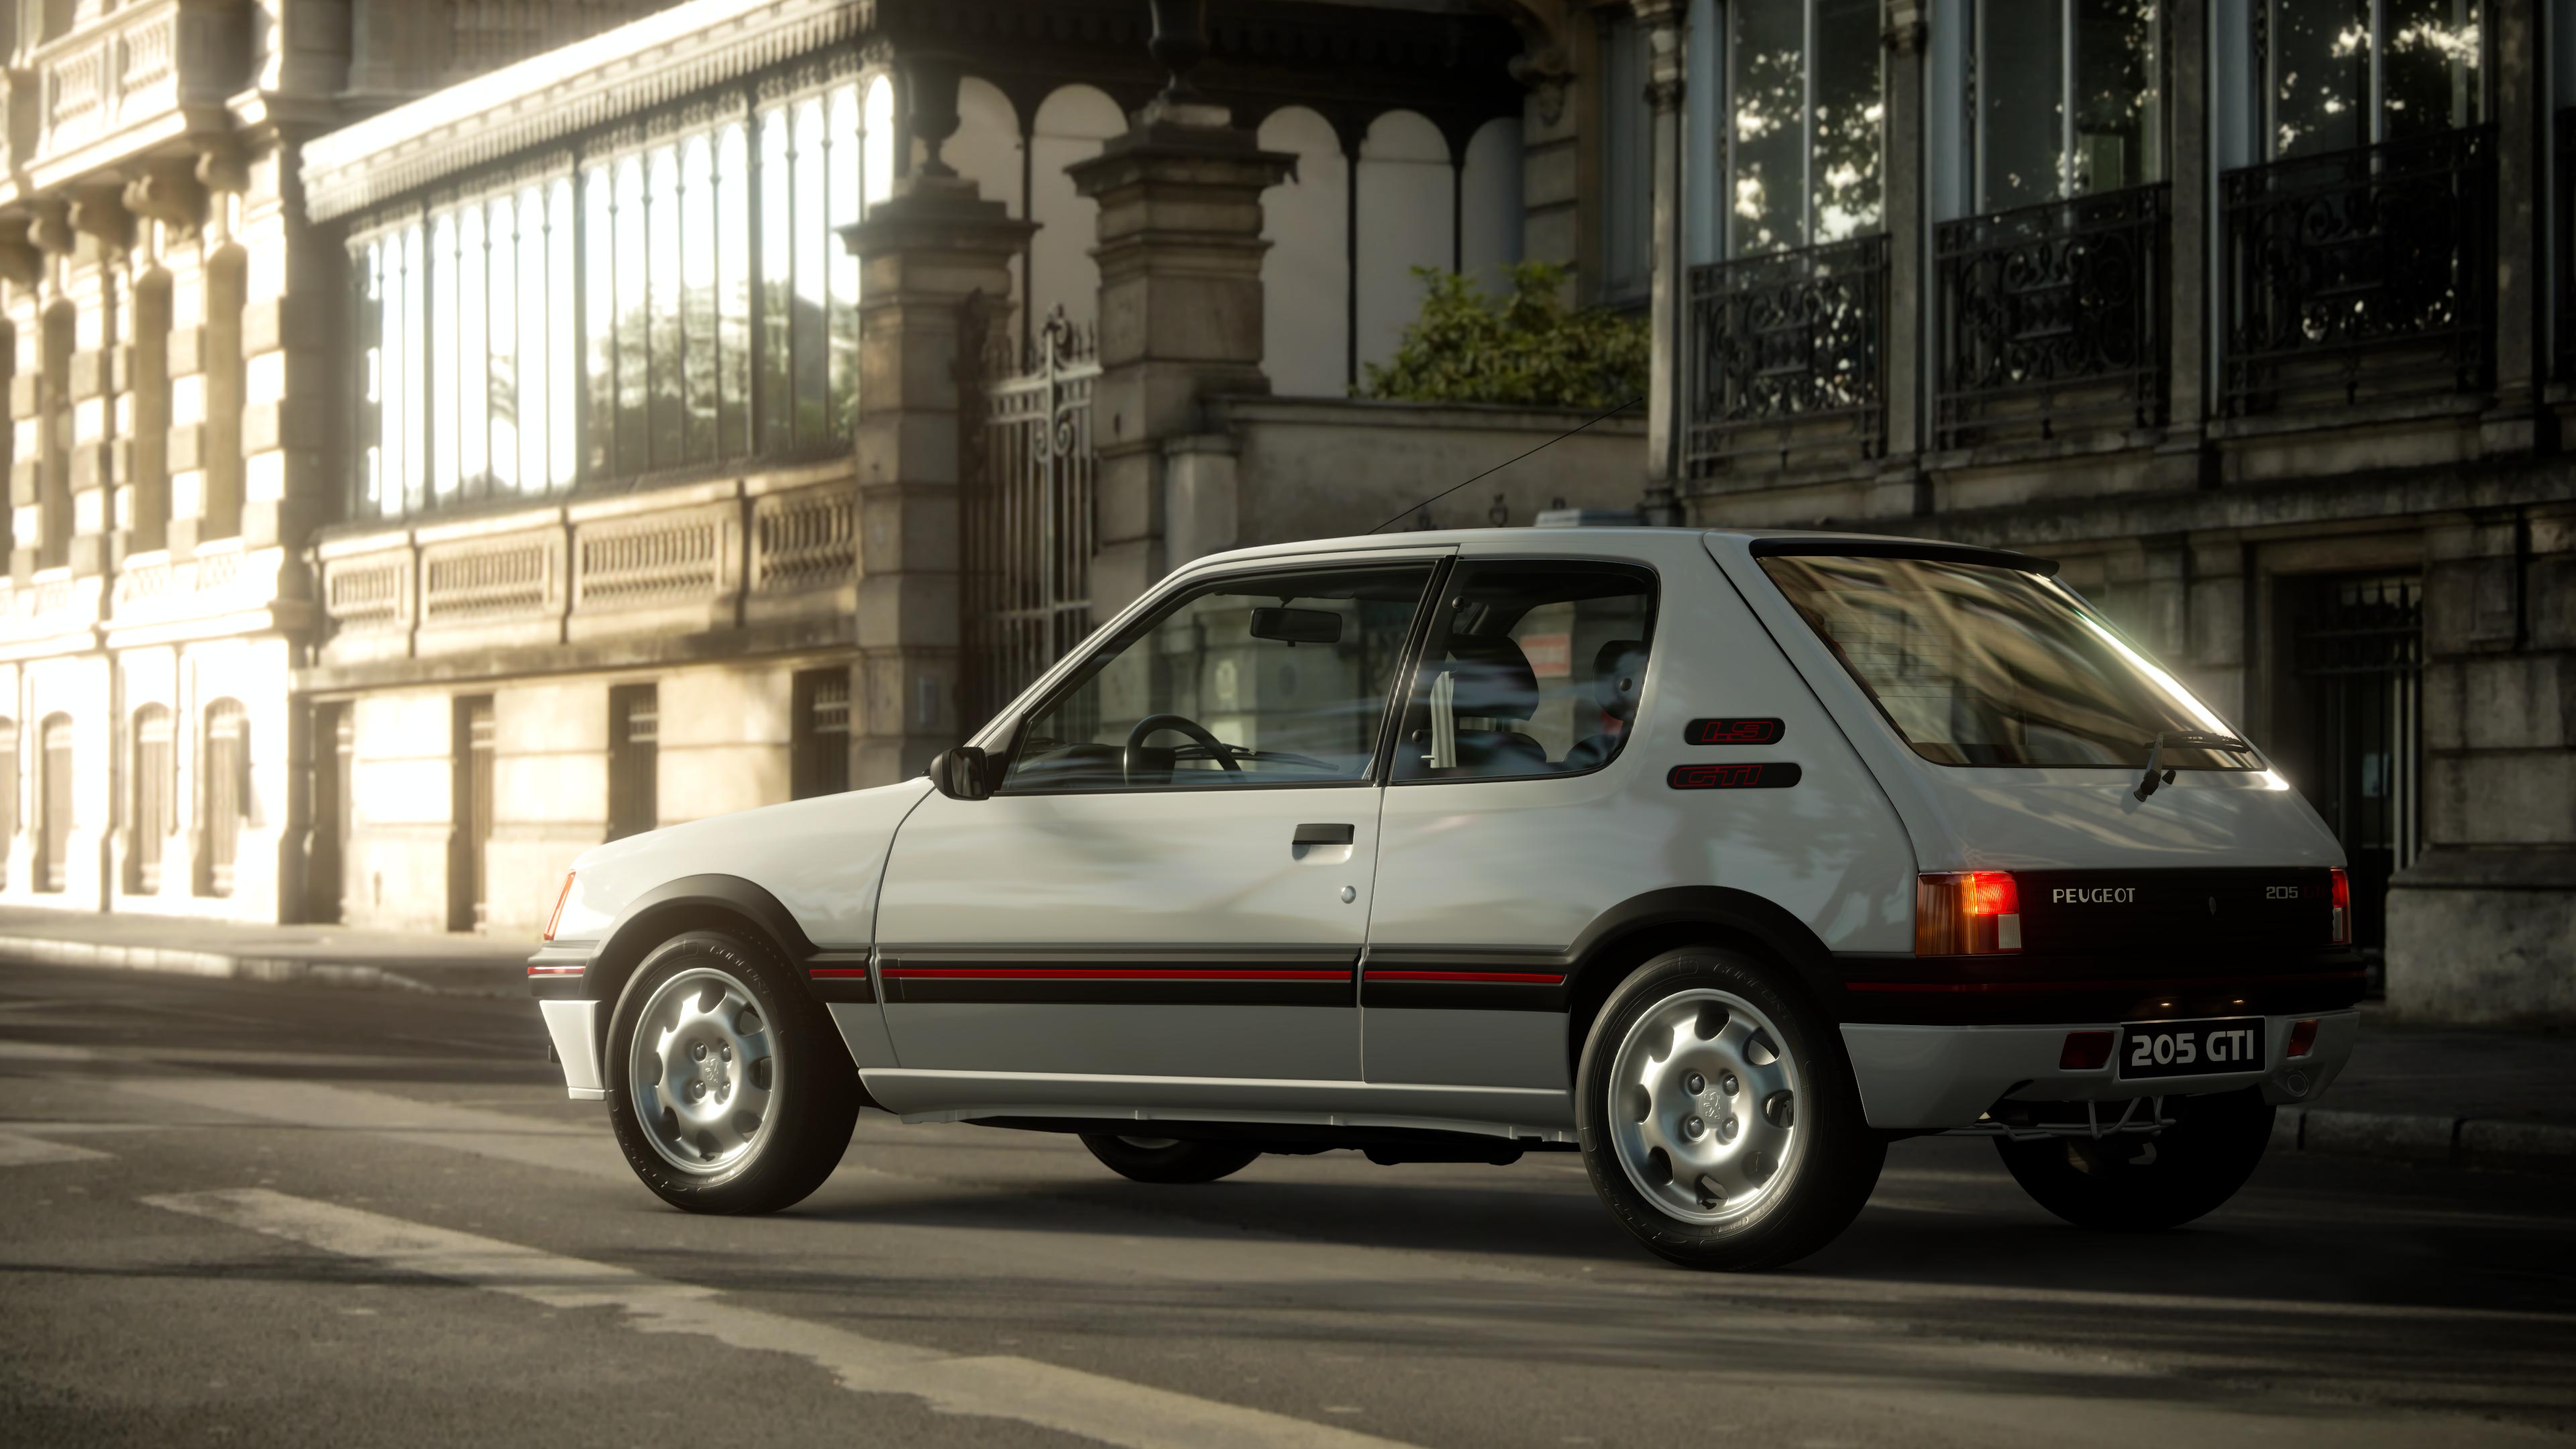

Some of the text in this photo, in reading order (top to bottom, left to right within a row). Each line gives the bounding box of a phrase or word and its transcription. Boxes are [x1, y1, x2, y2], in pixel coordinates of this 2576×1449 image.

[1674, 765, 1763, 788] GTI
[2053, 887, 2135, 904] PEUGEOT
[2265, 885, 2299, 900] 205
[2131, 1029, 2254, 1067] 205 GTI
